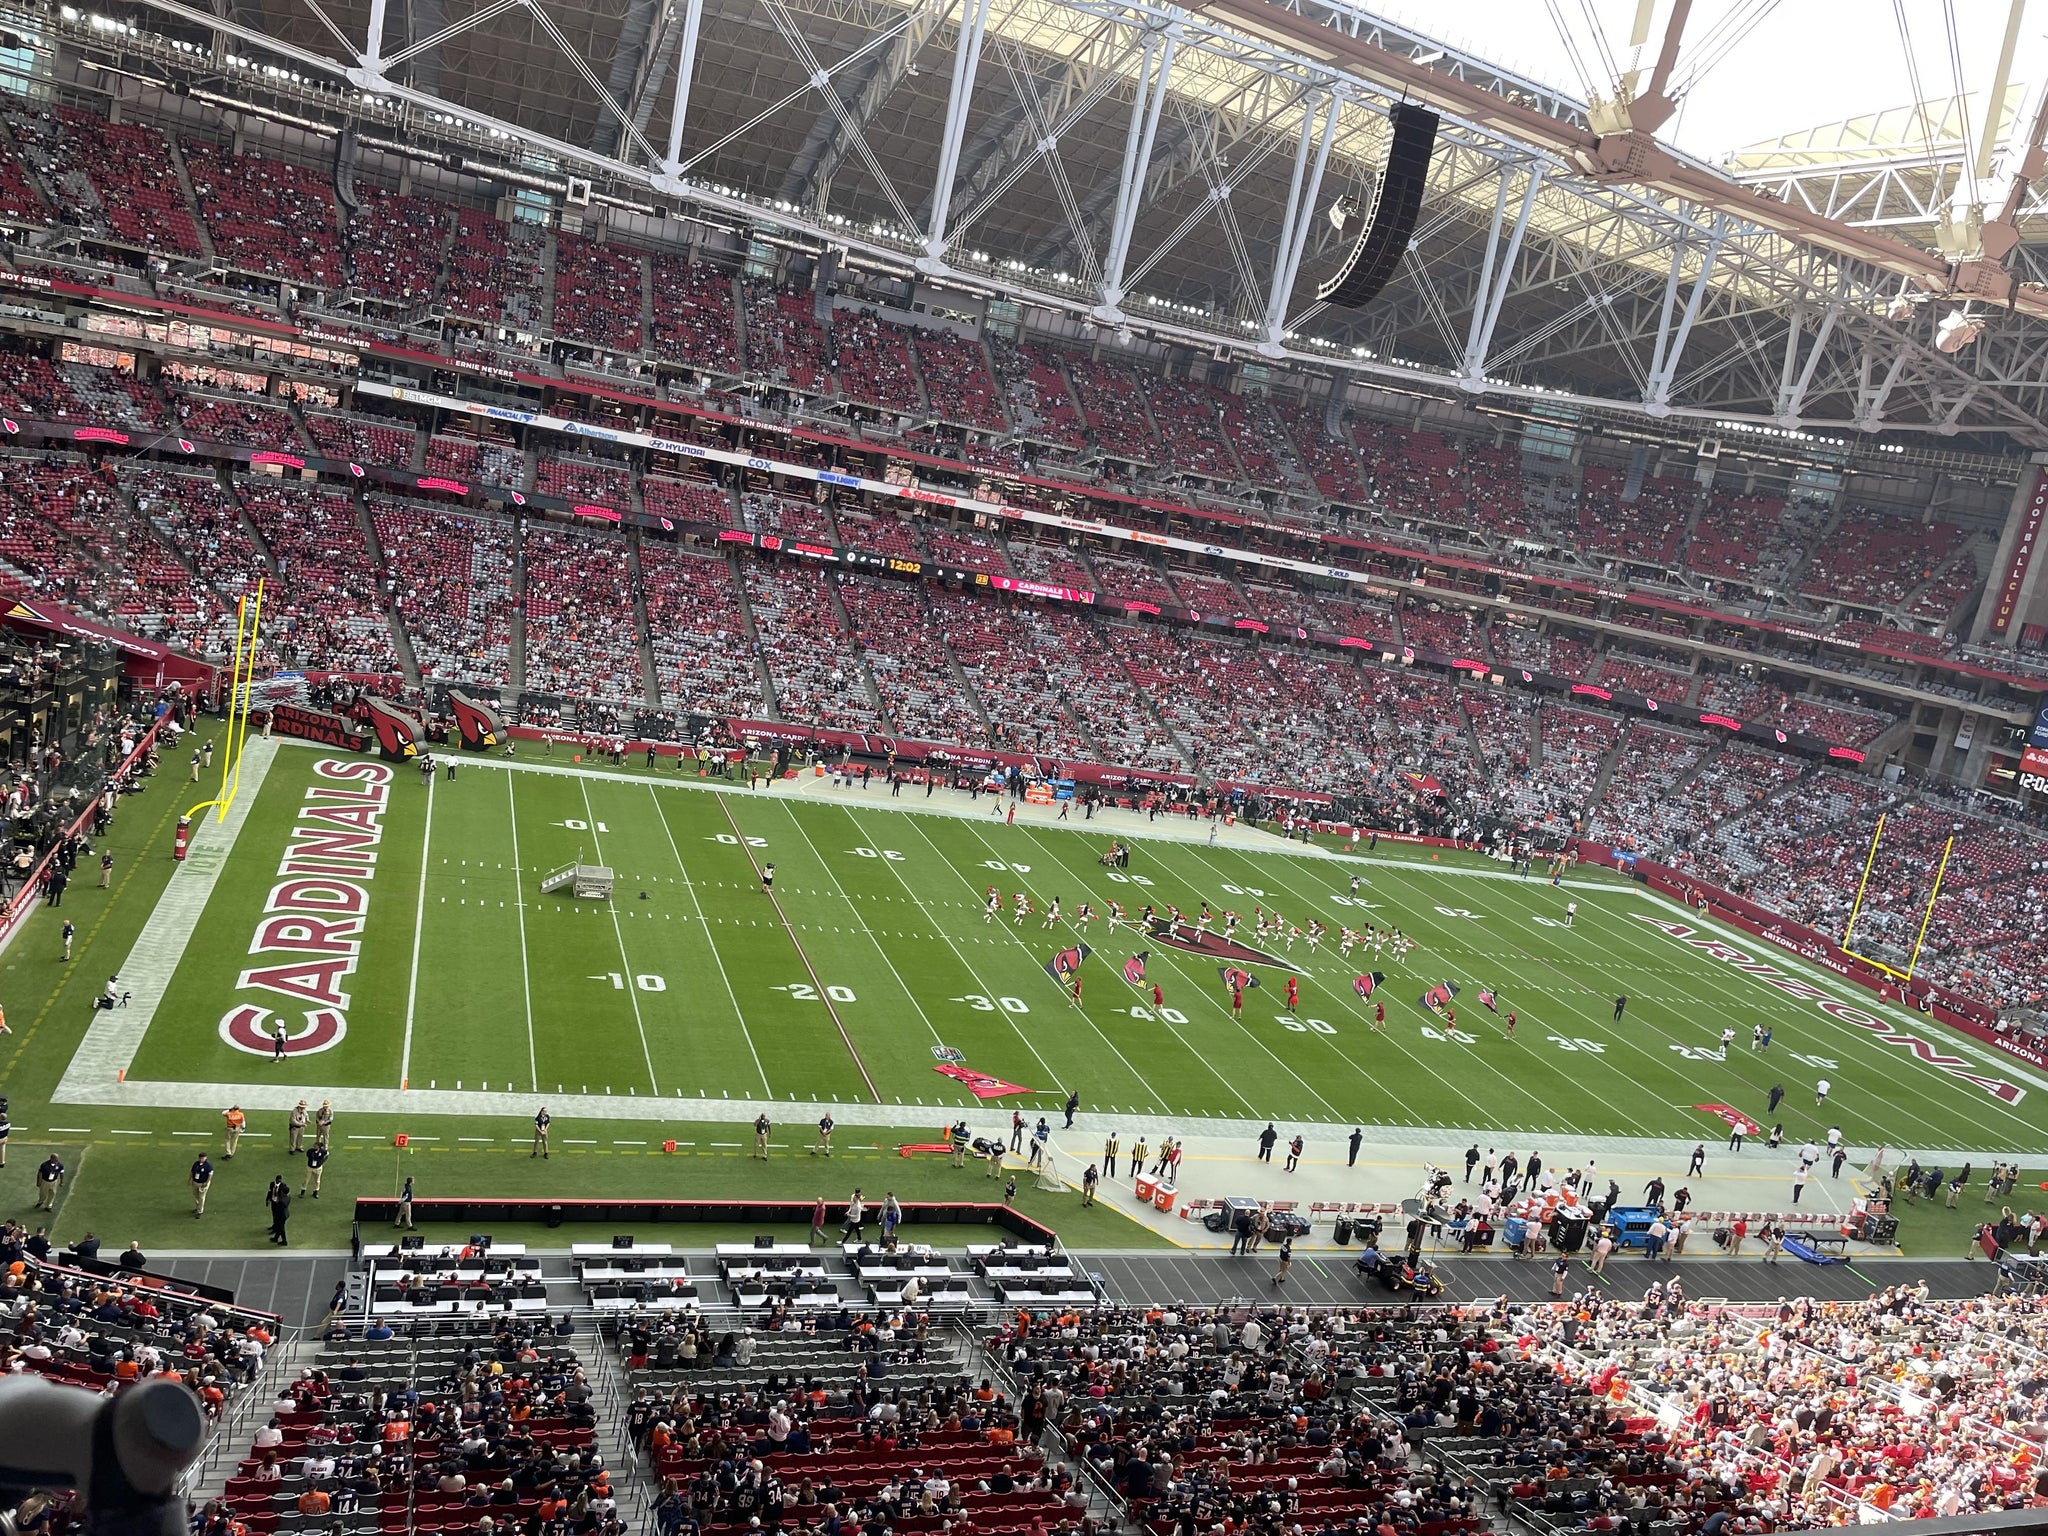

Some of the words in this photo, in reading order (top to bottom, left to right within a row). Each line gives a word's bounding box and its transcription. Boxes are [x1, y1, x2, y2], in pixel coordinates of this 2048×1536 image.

[21, 276, 51, 287] GREEN
[302, 330, 336, 342] CARSON
[338, 336, 370, 348] PALMER
[455, 360, 480, 370] ERNIE
[481, 365, 514, 378] NEVERS
[403, 391, 442, 405] BETMGM
[740, 418, 756, 427] DAN
[756, 422, 792, 434] DIERDORF
[665, 442, 706, 456] HYUNDAI
[748, 458, 773, 470] COX
[819, 472, 834, 482] BUD
[836, 476, 860, 487] LIGHT
[971, 466, 993, 475] LARRY
[994, 471, 1020, 480] WILSON
[914, 490, 935, 502] State
[935, 495, 956, 506] Farm
[1251, 521, 1265, 529] DICK
[1306, 532, 1322, 540] LANE
[2013, 484, 2048, 578] FOOTBALL
[889, 558, 921, 574] 12:02
[1488, 568, 1506, 576] KURT
[1507, 571, 1533, 580] WARNER
[1003, 579, 1010, 588] 0
[1018, 582, 1063, 595] CARDINALS
[1610, 592, 1628, 600] HART
[1997, 582, 2016, 627] CLUB
[62, 622, 159, 656] verizon
[1785, 628, 1822, 640] MARSHALL
[1823, 636, 1860, 648] GOLDBERG
[274, 706, 341, 730] ARIZONA
[250, 712, 362, 750] CRDINALS
[740, 728, 778, 738] ARIZONA
[564, 819, 610, 832] 10
[716, 833, 769, 848] 20
[182, 844, 225, 876] VOTE
[855, 846, 906, 862] 30
[985, 860, 1032, 874] 40
[1106, 872, 1156, 888] 50
[1221, 884, 1265, 898] 40
[218, 757, 396, 1058] CARDINALS
[1330, 895, 1376, 909] 30
[1434, 906, 1480, 920] 20
[1762, 930, 1798, 952] ARIZONA
[606, 972, 666, 992] 10
[785, 982, 857, 1002] 20
[964, 994, 1030, 1014] 30
[1628, 910, 2027, 1106] ARIZONA
[1130, 1006, 1190, 1024] 40
[1274, 1016, 1338, 1034] 50
[1547, 1036, 1606, 1053] 30
[1994, 1037, 2042, 1066] ARIZONA
[1668, 1045, 1726, 1062] 20
[398, 1136, 406, 1146] G
[666, 1141, 675, 1151] 10
[1138, 1184, 1146, 1194] G
[1157, 1194, 1165, 1204] G
[157, 1328, 170, 1337] 50
[1273, 1384, 1284, 1394] 23
[1406, 1388, 1418, 1398] 23
[634, 1413, 643, 1424] 18
[768, 1486, 782, 1506] 34
[338, 1500, 350, 1514] 14
[1287, 1499, 1300, 1512] 34
